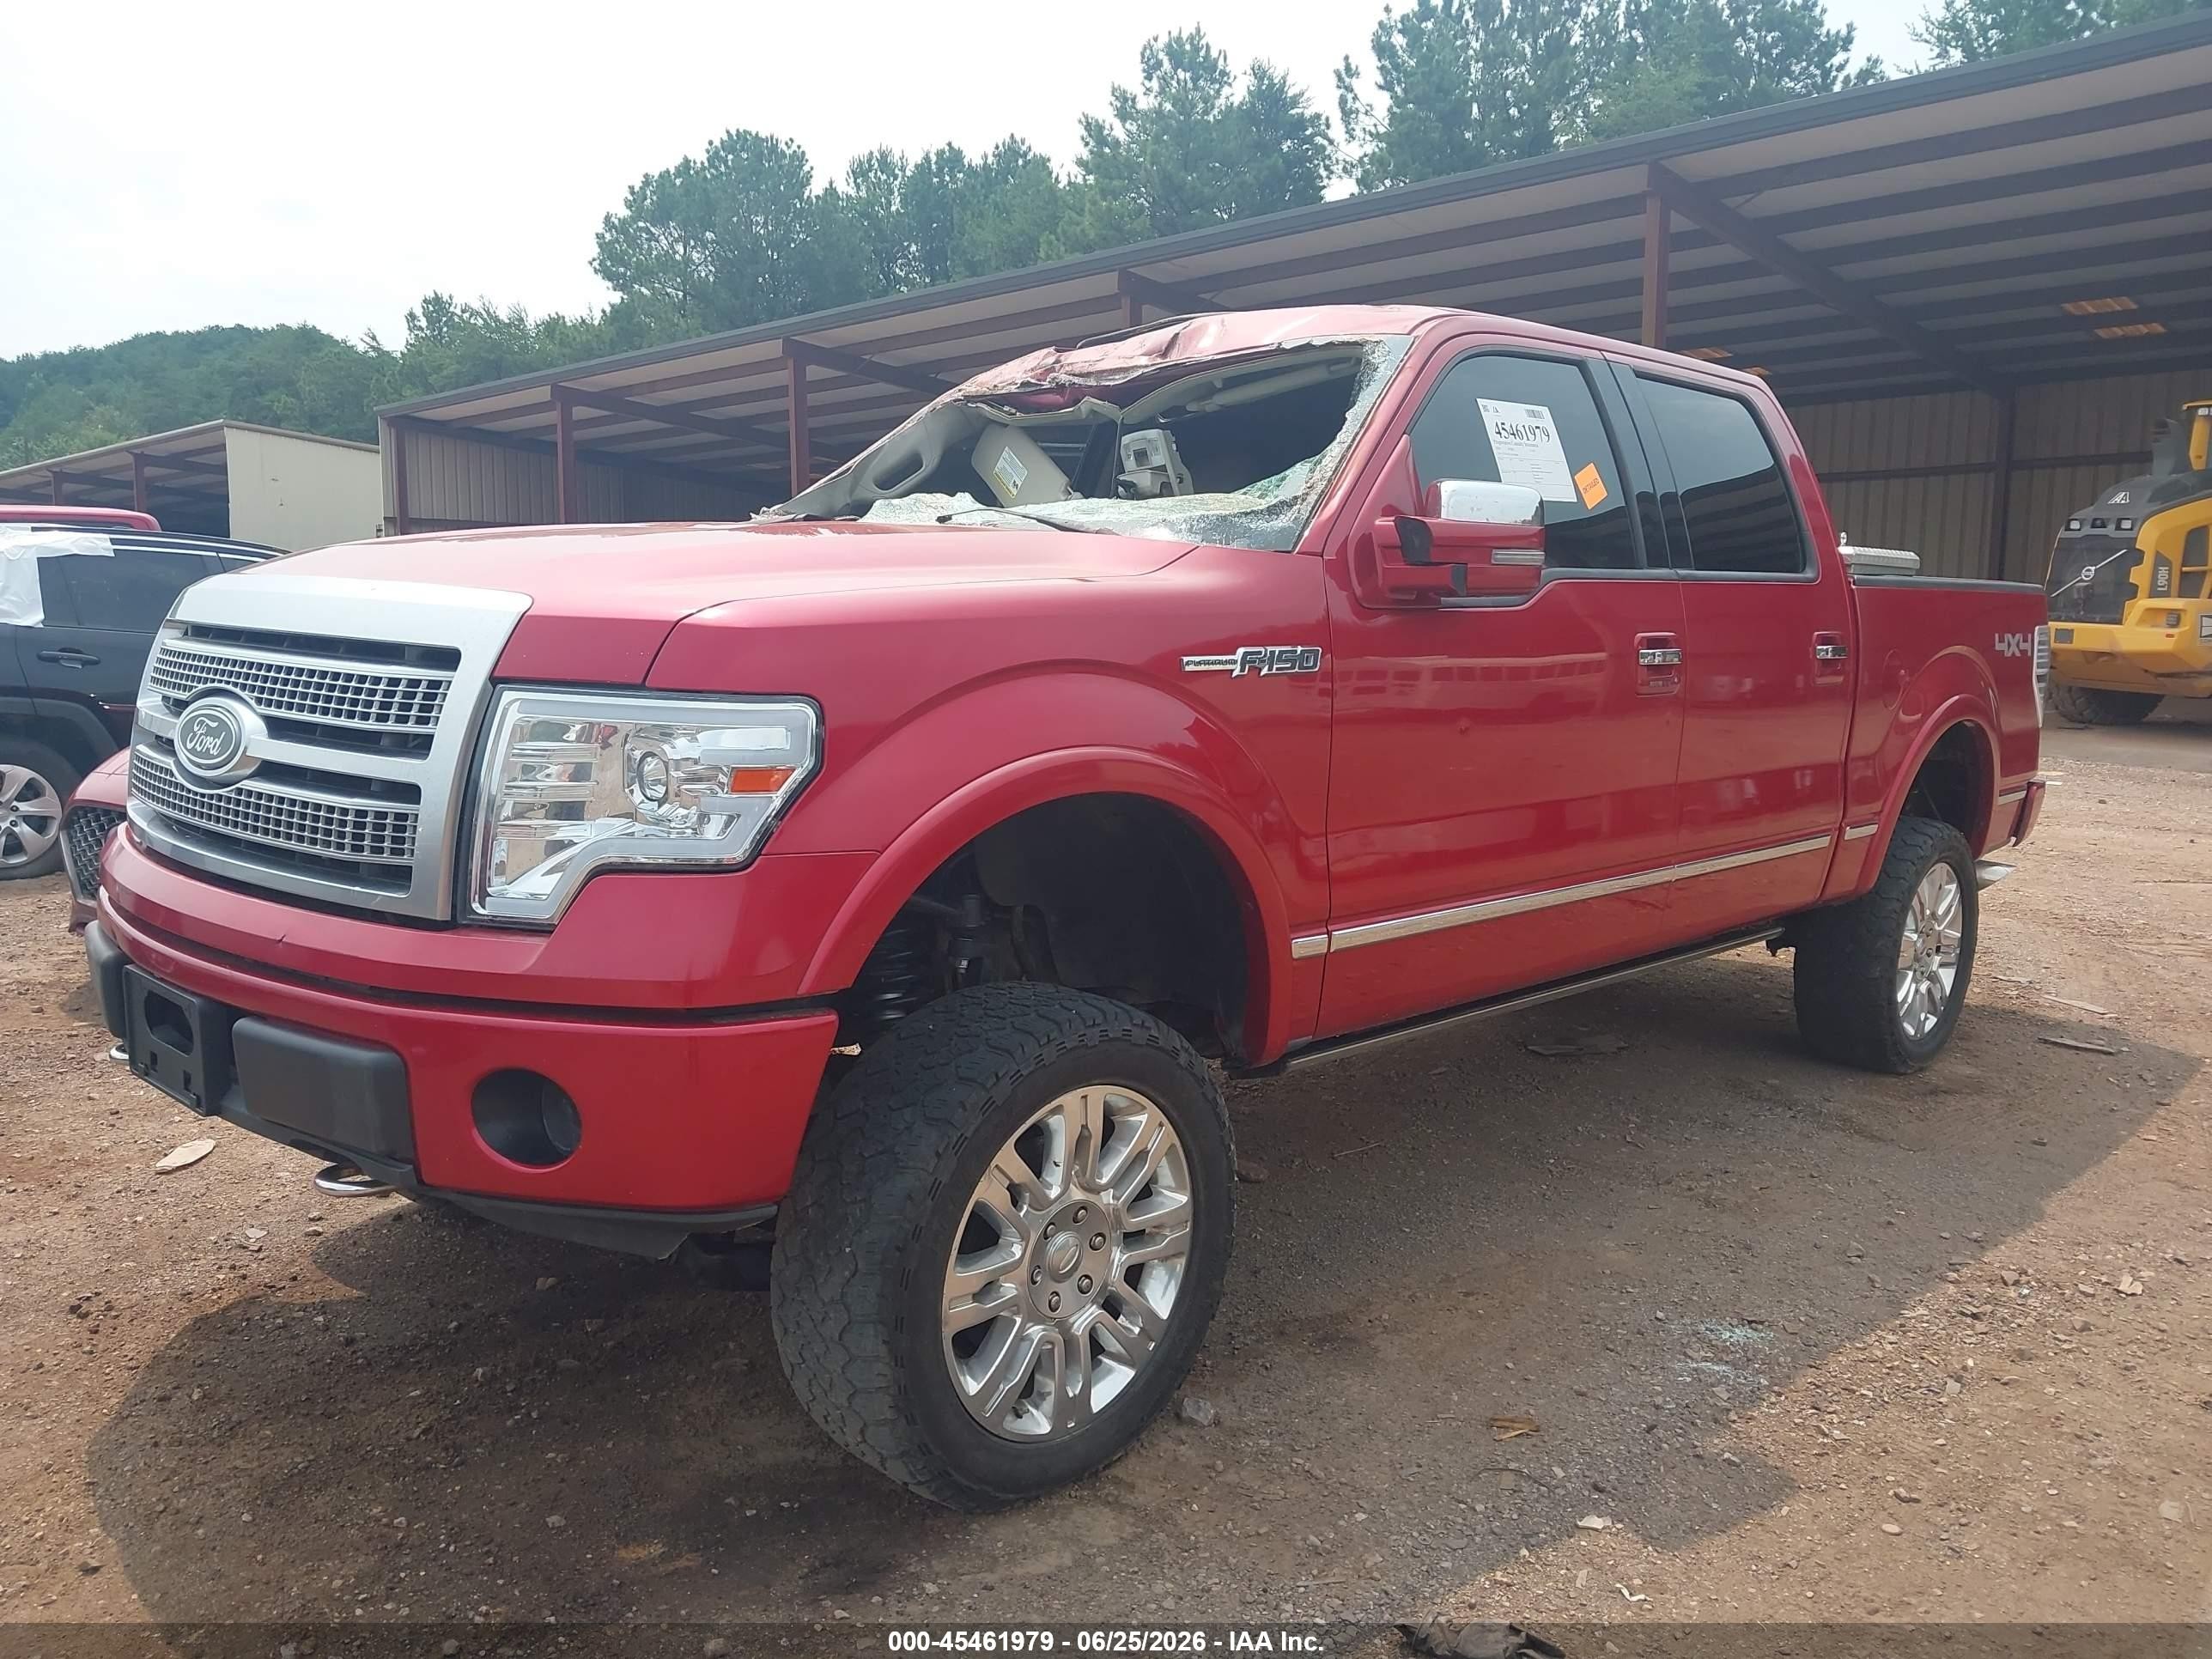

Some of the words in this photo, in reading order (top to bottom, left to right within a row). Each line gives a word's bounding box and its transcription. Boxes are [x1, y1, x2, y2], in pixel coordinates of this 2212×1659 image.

[1494, 421, 1550, 443] 45461979
[2157, 567, 2170, 591] L90H
[186, 717, 226, 756] Ford
